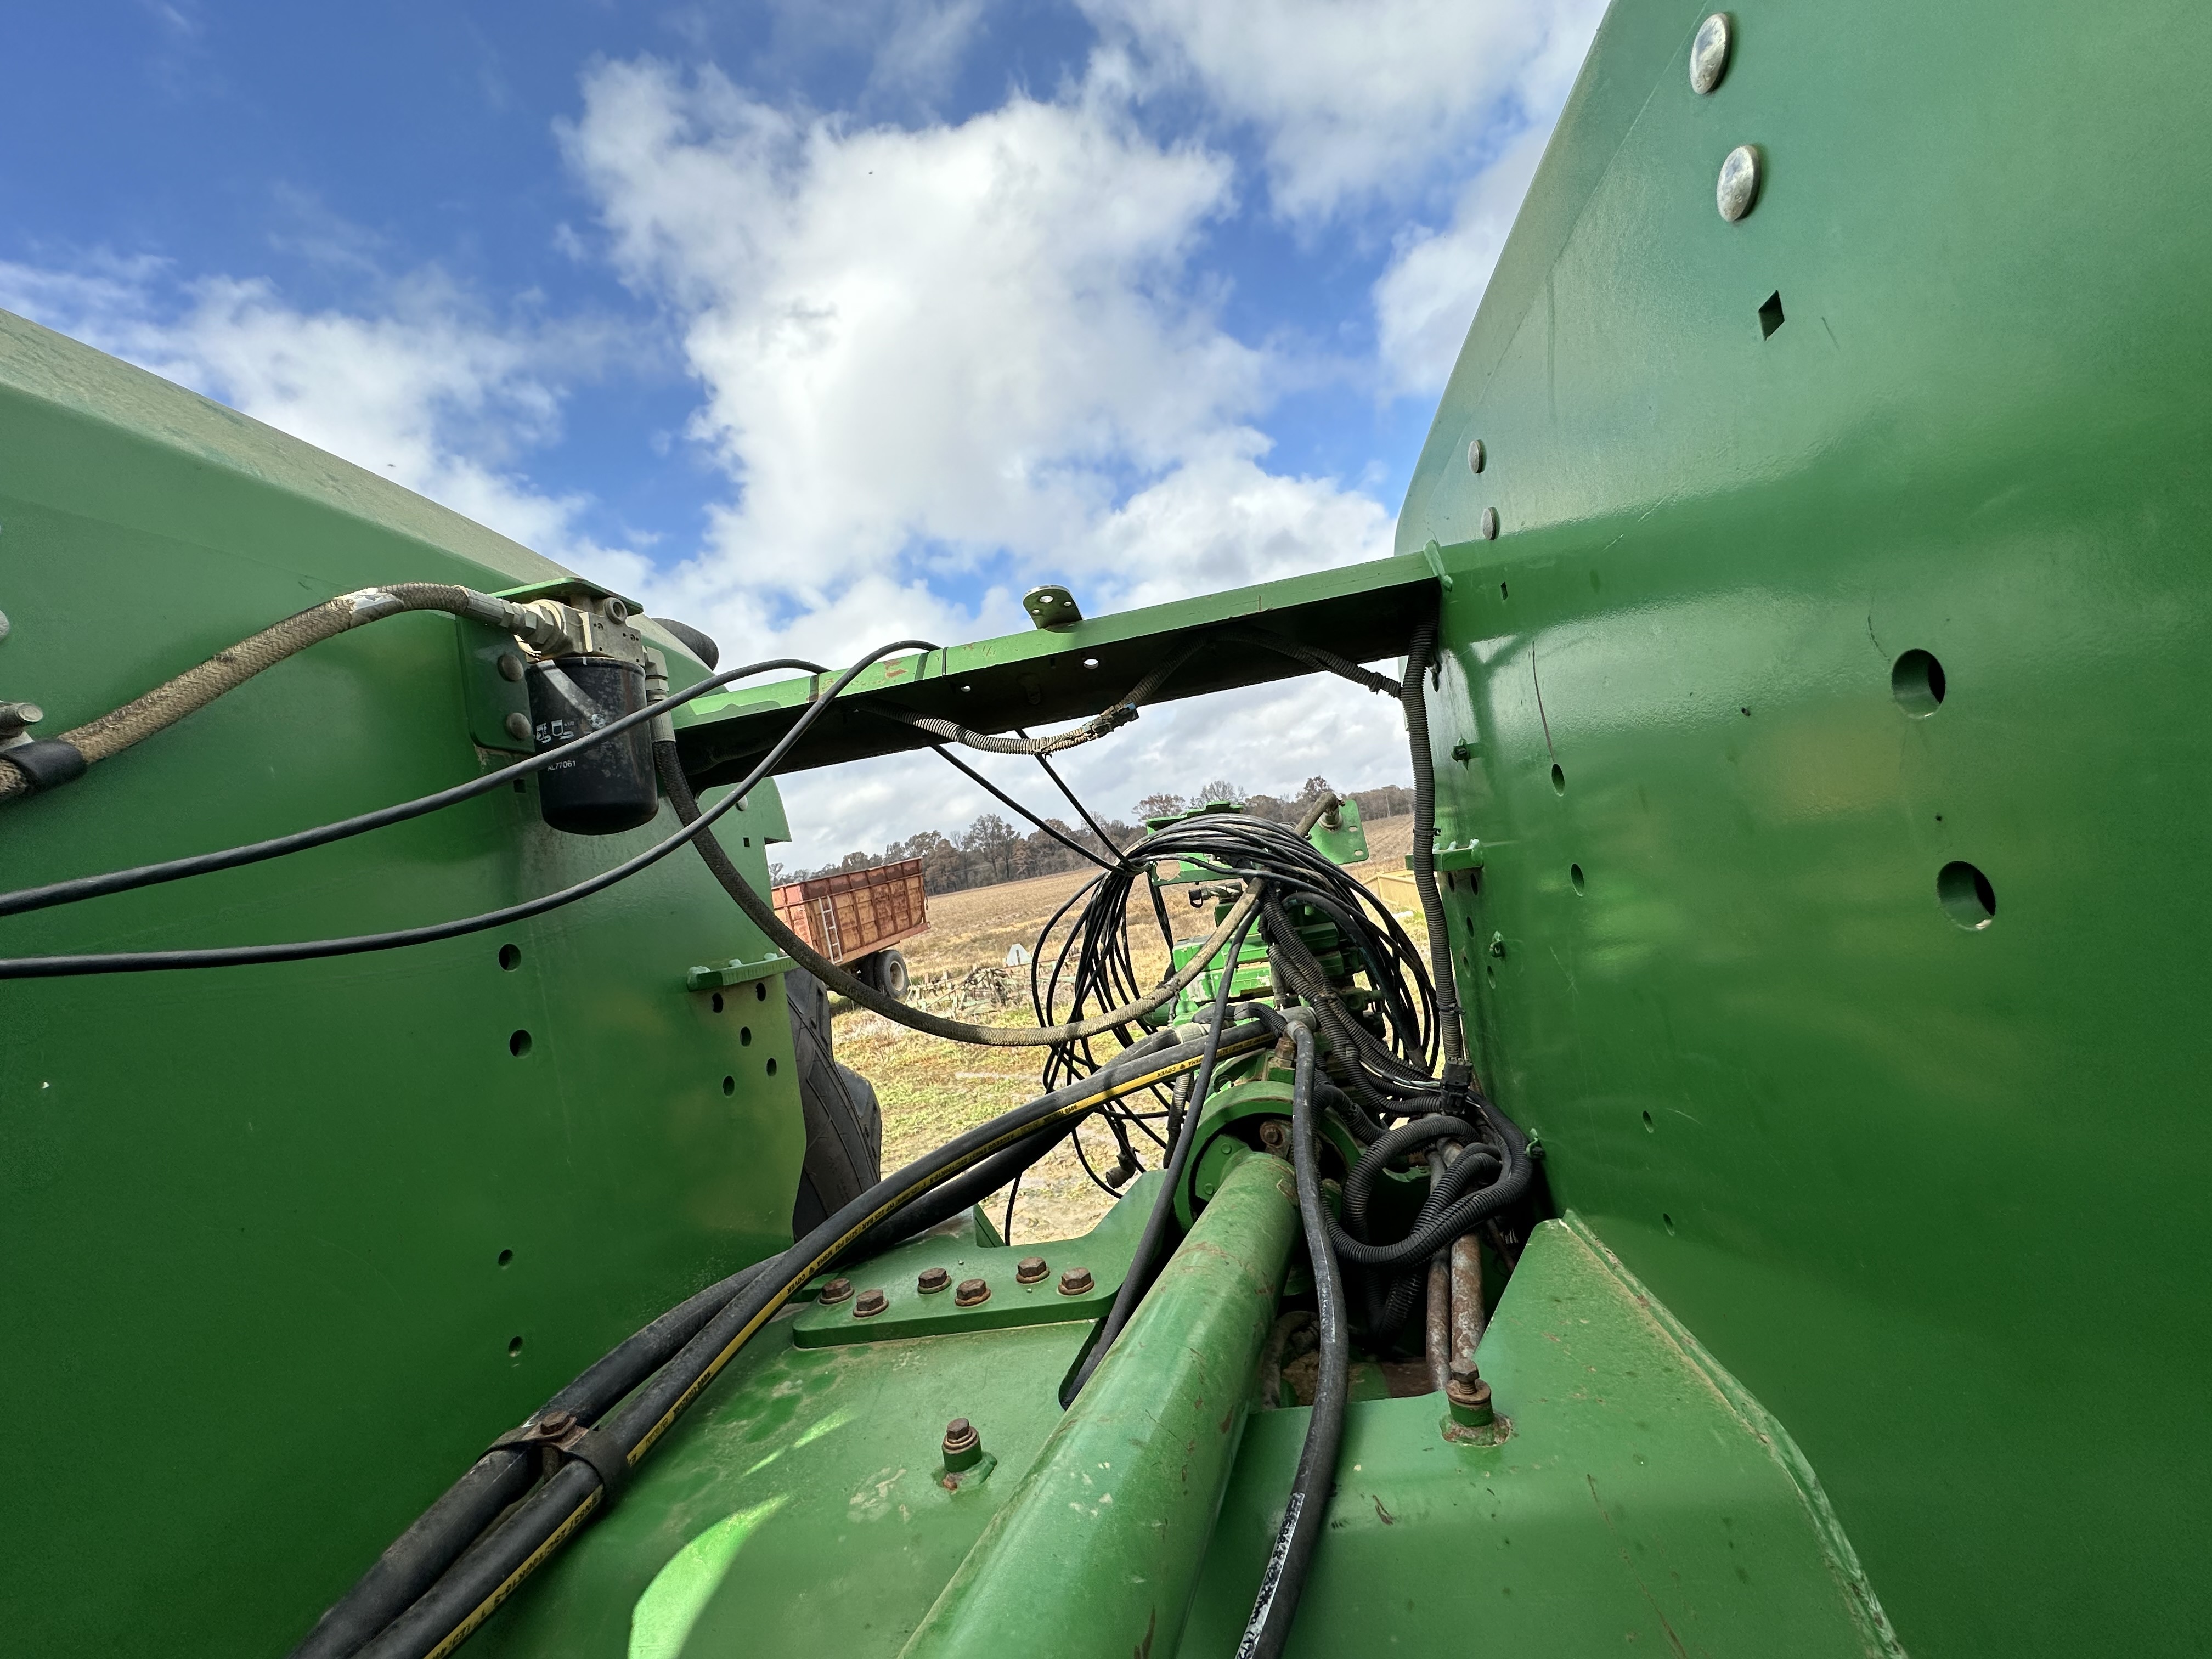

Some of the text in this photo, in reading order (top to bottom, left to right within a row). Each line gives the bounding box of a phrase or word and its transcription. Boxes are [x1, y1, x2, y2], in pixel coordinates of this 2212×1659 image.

[548, 760, 576, 772] AL77061
[1156, 1066, 1175, 1077] COVER
[885, 1202, 894, 1212] WP
[874, 1209, 885, 1220] 225
[862, 1216, 873, 1229] BAR
[816, 1249, 833, 1267] MSHA
[786, 1273, 805, 1294] COVER
